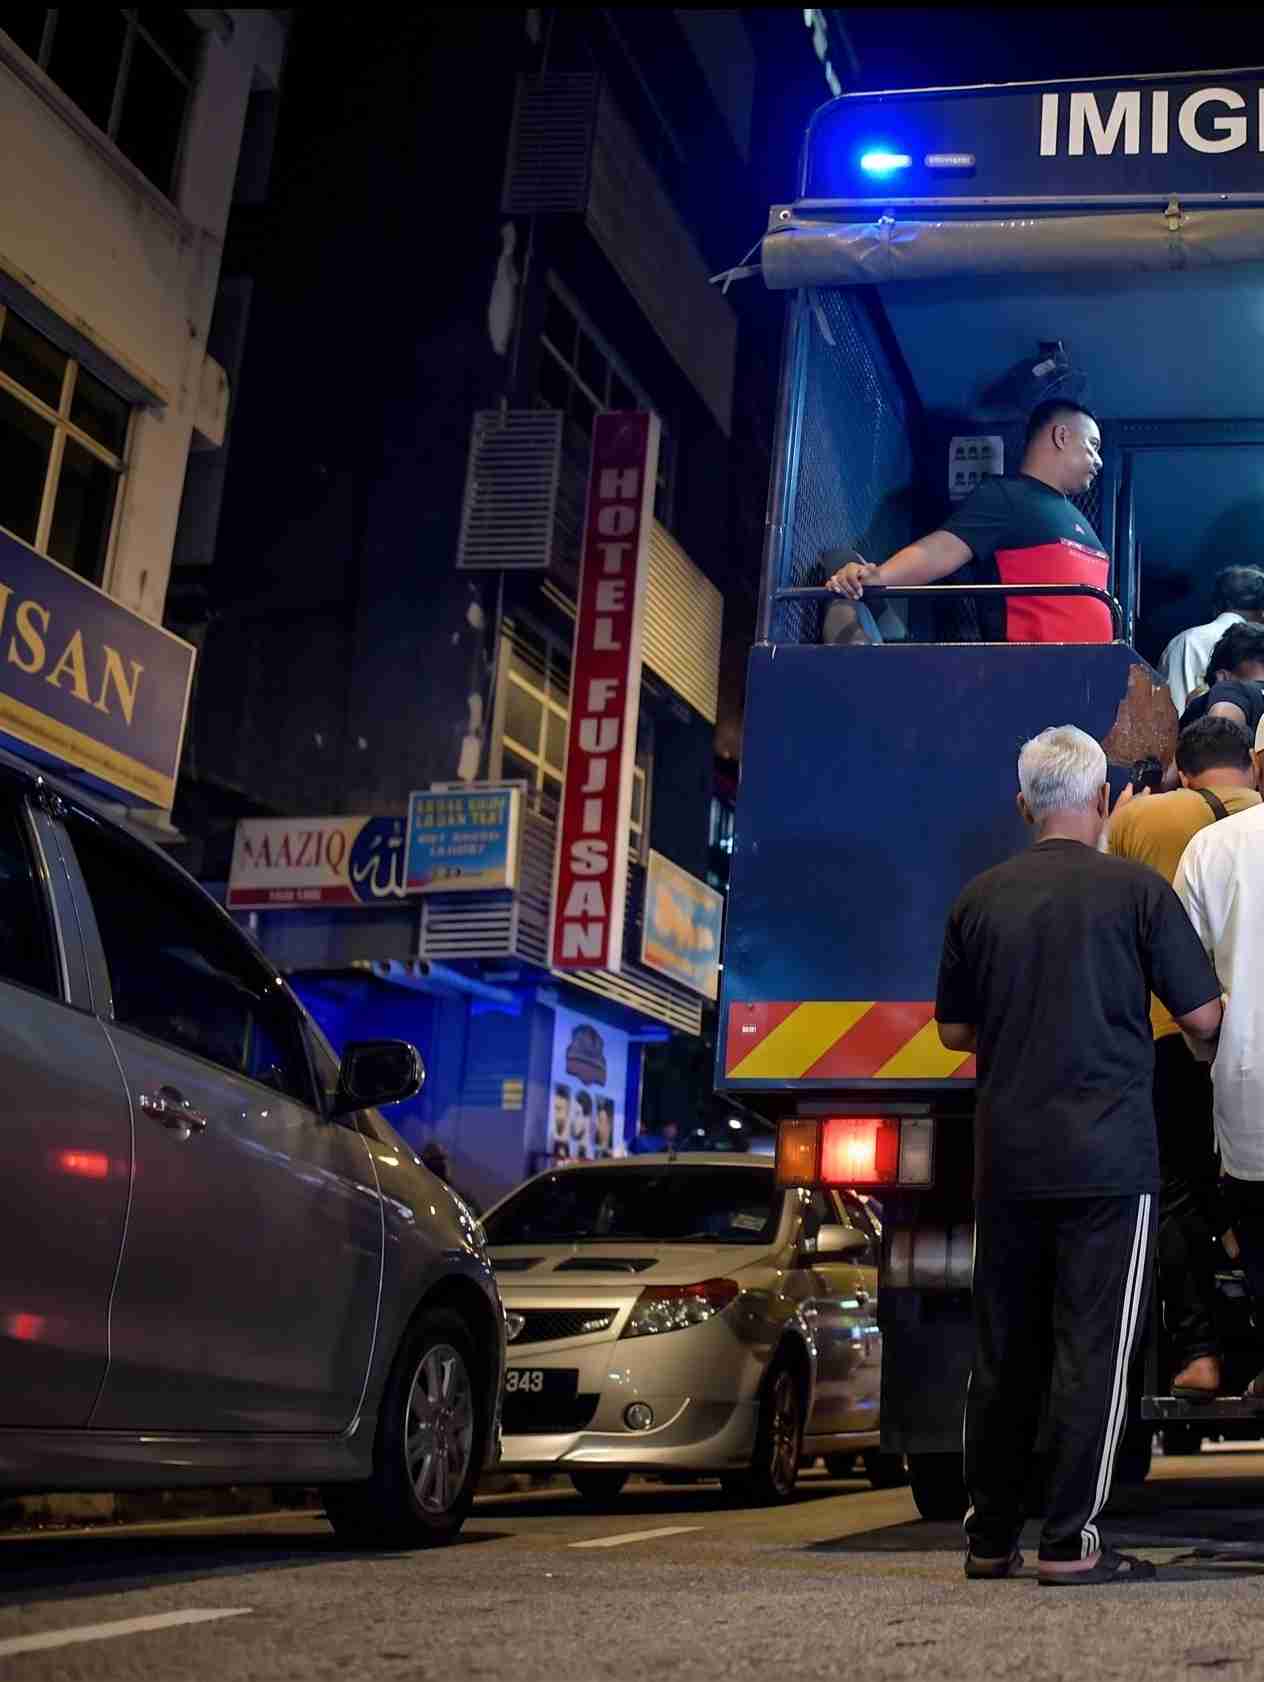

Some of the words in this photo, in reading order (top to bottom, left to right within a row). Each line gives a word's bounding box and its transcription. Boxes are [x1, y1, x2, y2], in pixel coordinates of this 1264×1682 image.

[593, 467, 639, 650] HOTEL
[561, 678, 619, 959] FUJISAN
[505, 1371, 544, 1392] 343
